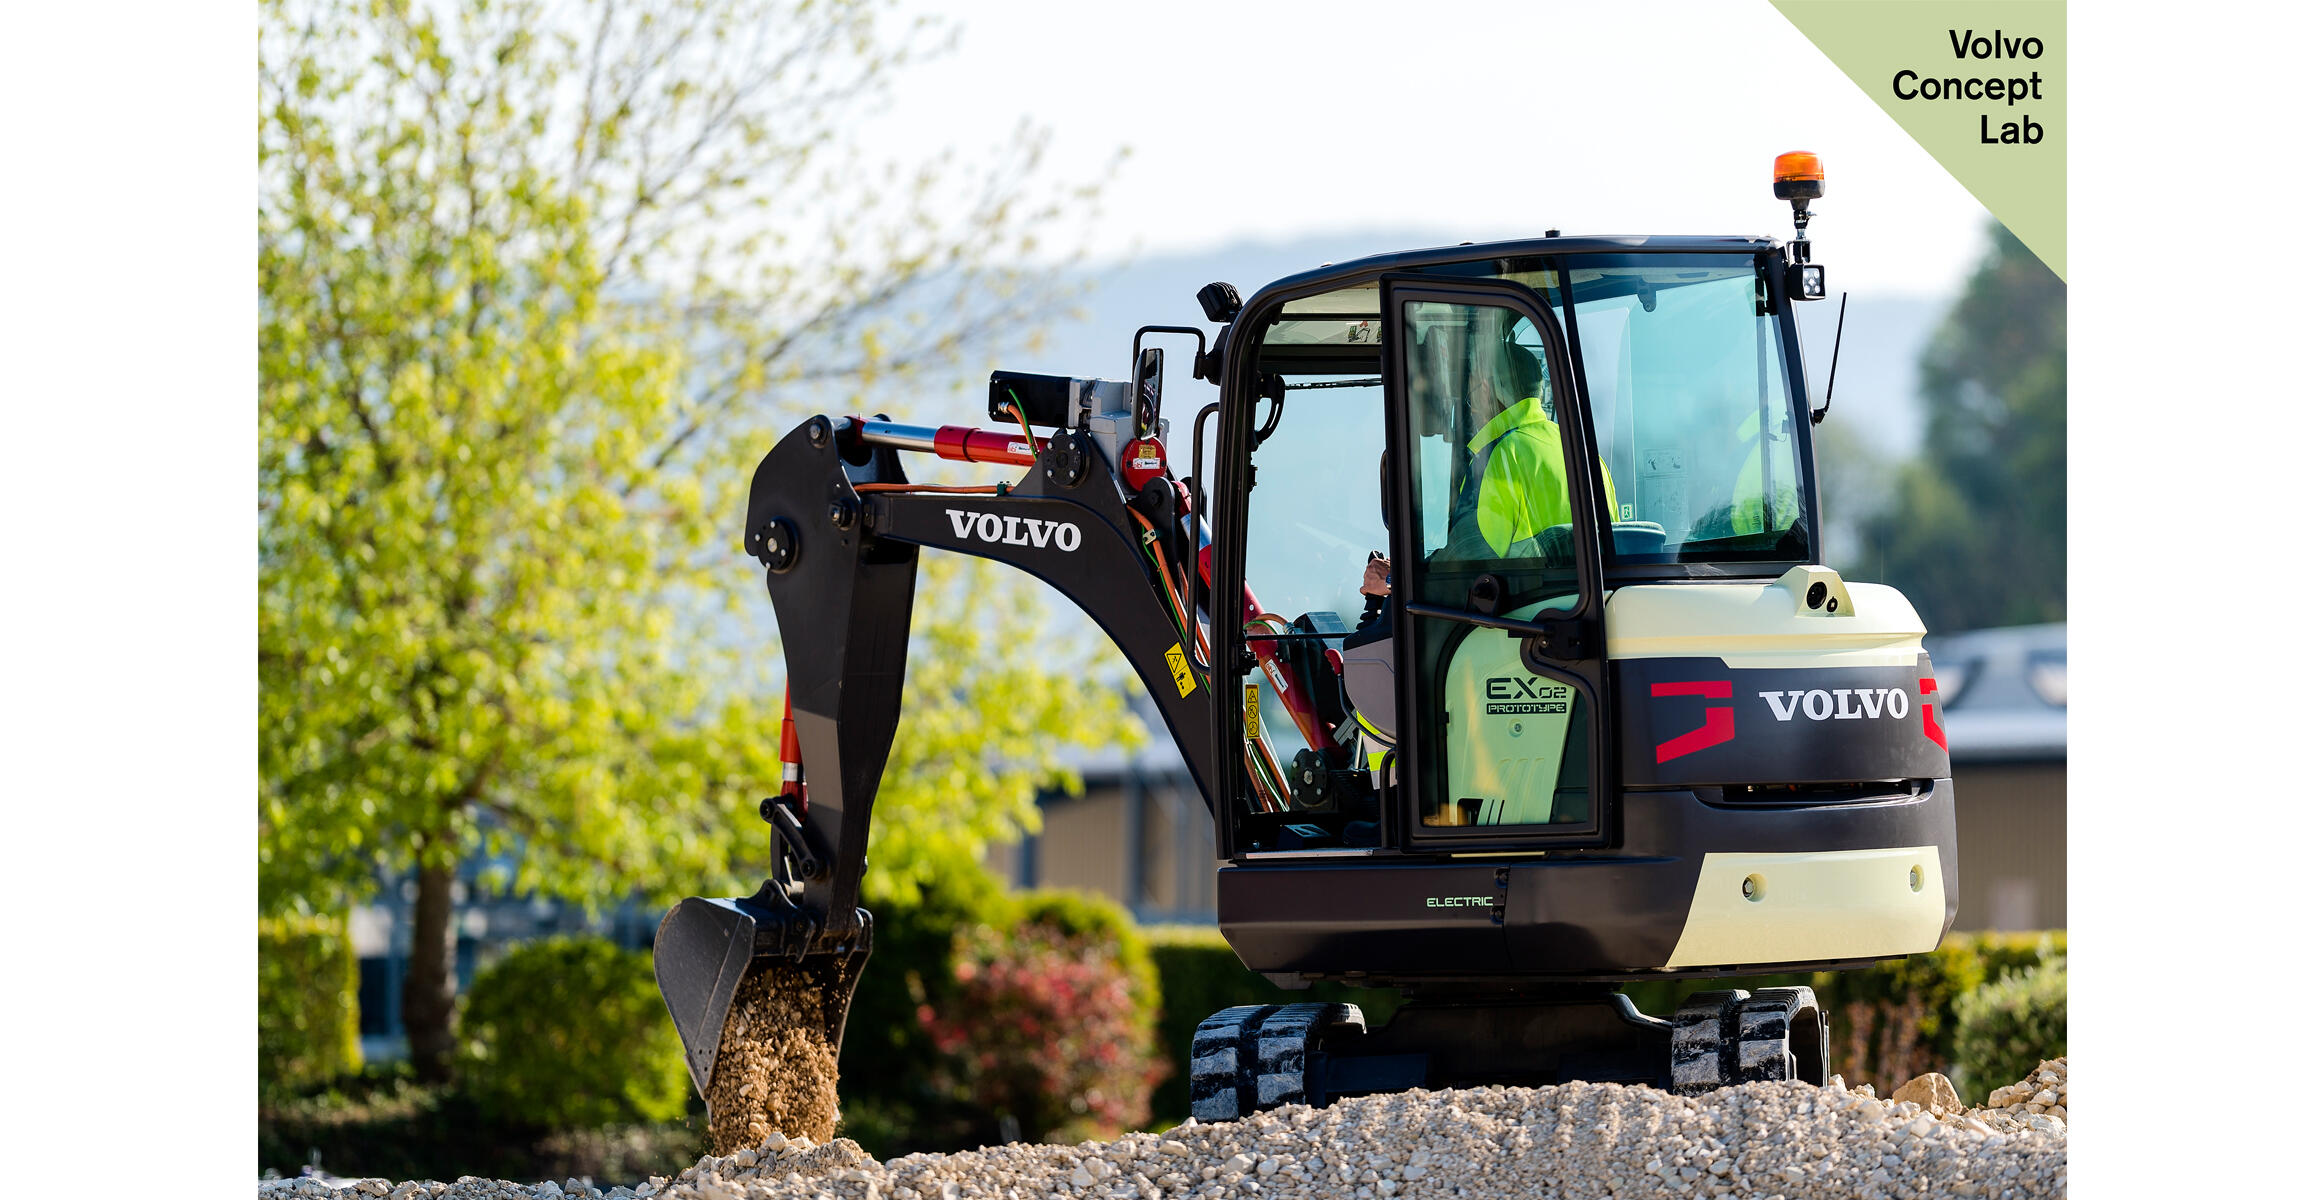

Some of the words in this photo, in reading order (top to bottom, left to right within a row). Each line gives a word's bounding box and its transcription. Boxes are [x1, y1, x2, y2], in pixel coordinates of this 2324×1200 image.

[945, 508, 1082, 552] VOLVO
[1488, 703, 1566, 713] PROTOTYPE
[1759, 688, 1909, 721] VOLVO
[1426, 896, 1494, 907] ELECTRIC
